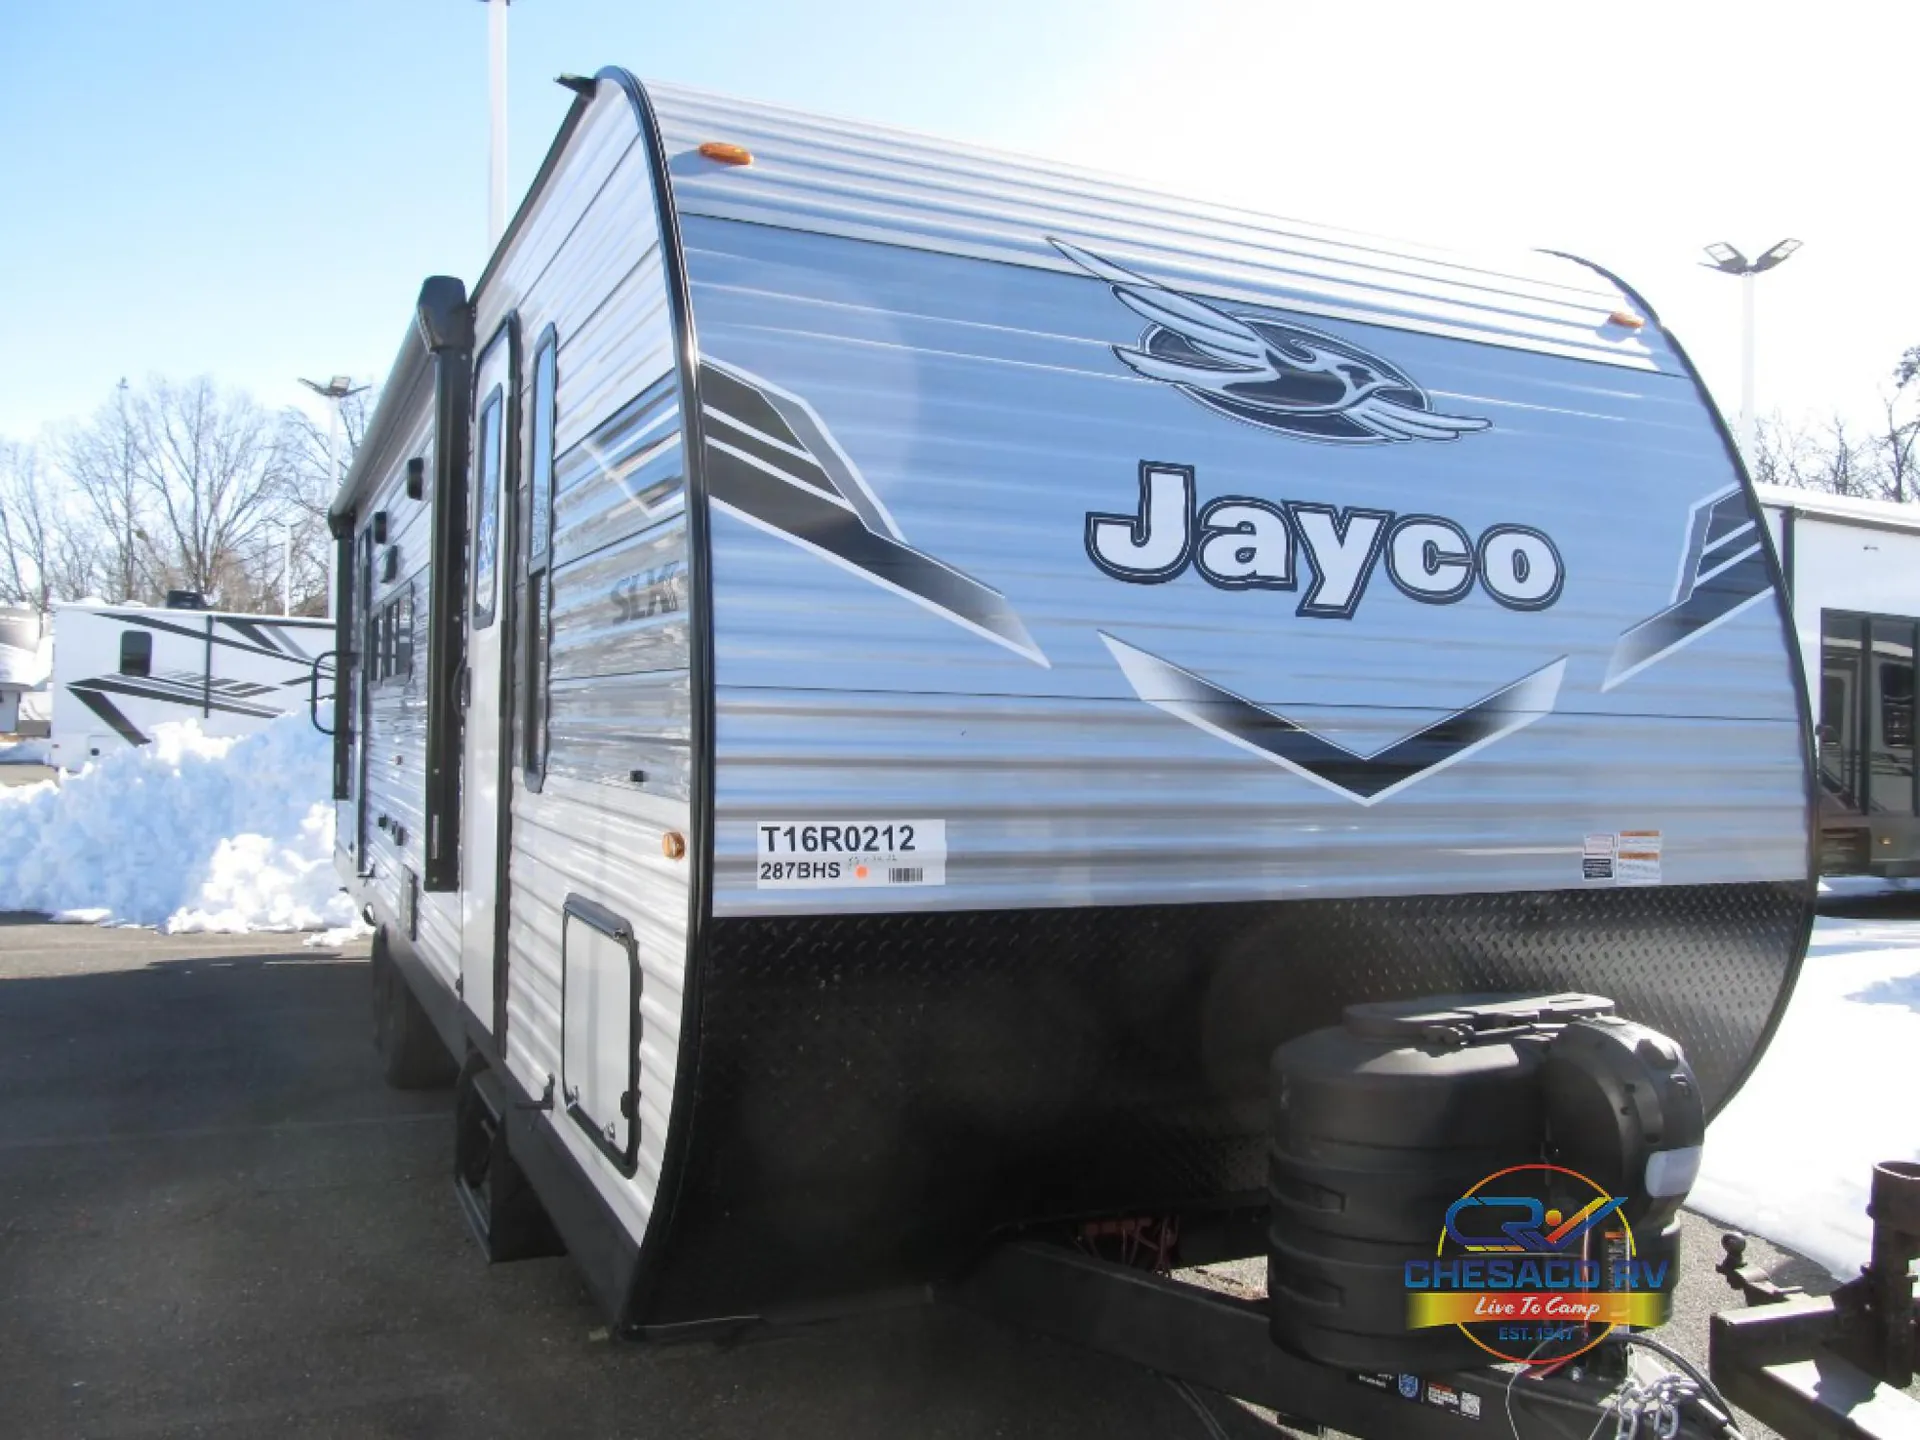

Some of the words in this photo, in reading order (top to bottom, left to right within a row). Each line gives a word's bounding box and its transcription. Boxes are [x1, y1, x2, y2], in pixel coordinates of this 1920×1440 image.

[1085, 460, 1565, 620] Jayco
[760, 825, 916, 852] T16R0212
[760, 862, 841, 880] 287BHS
